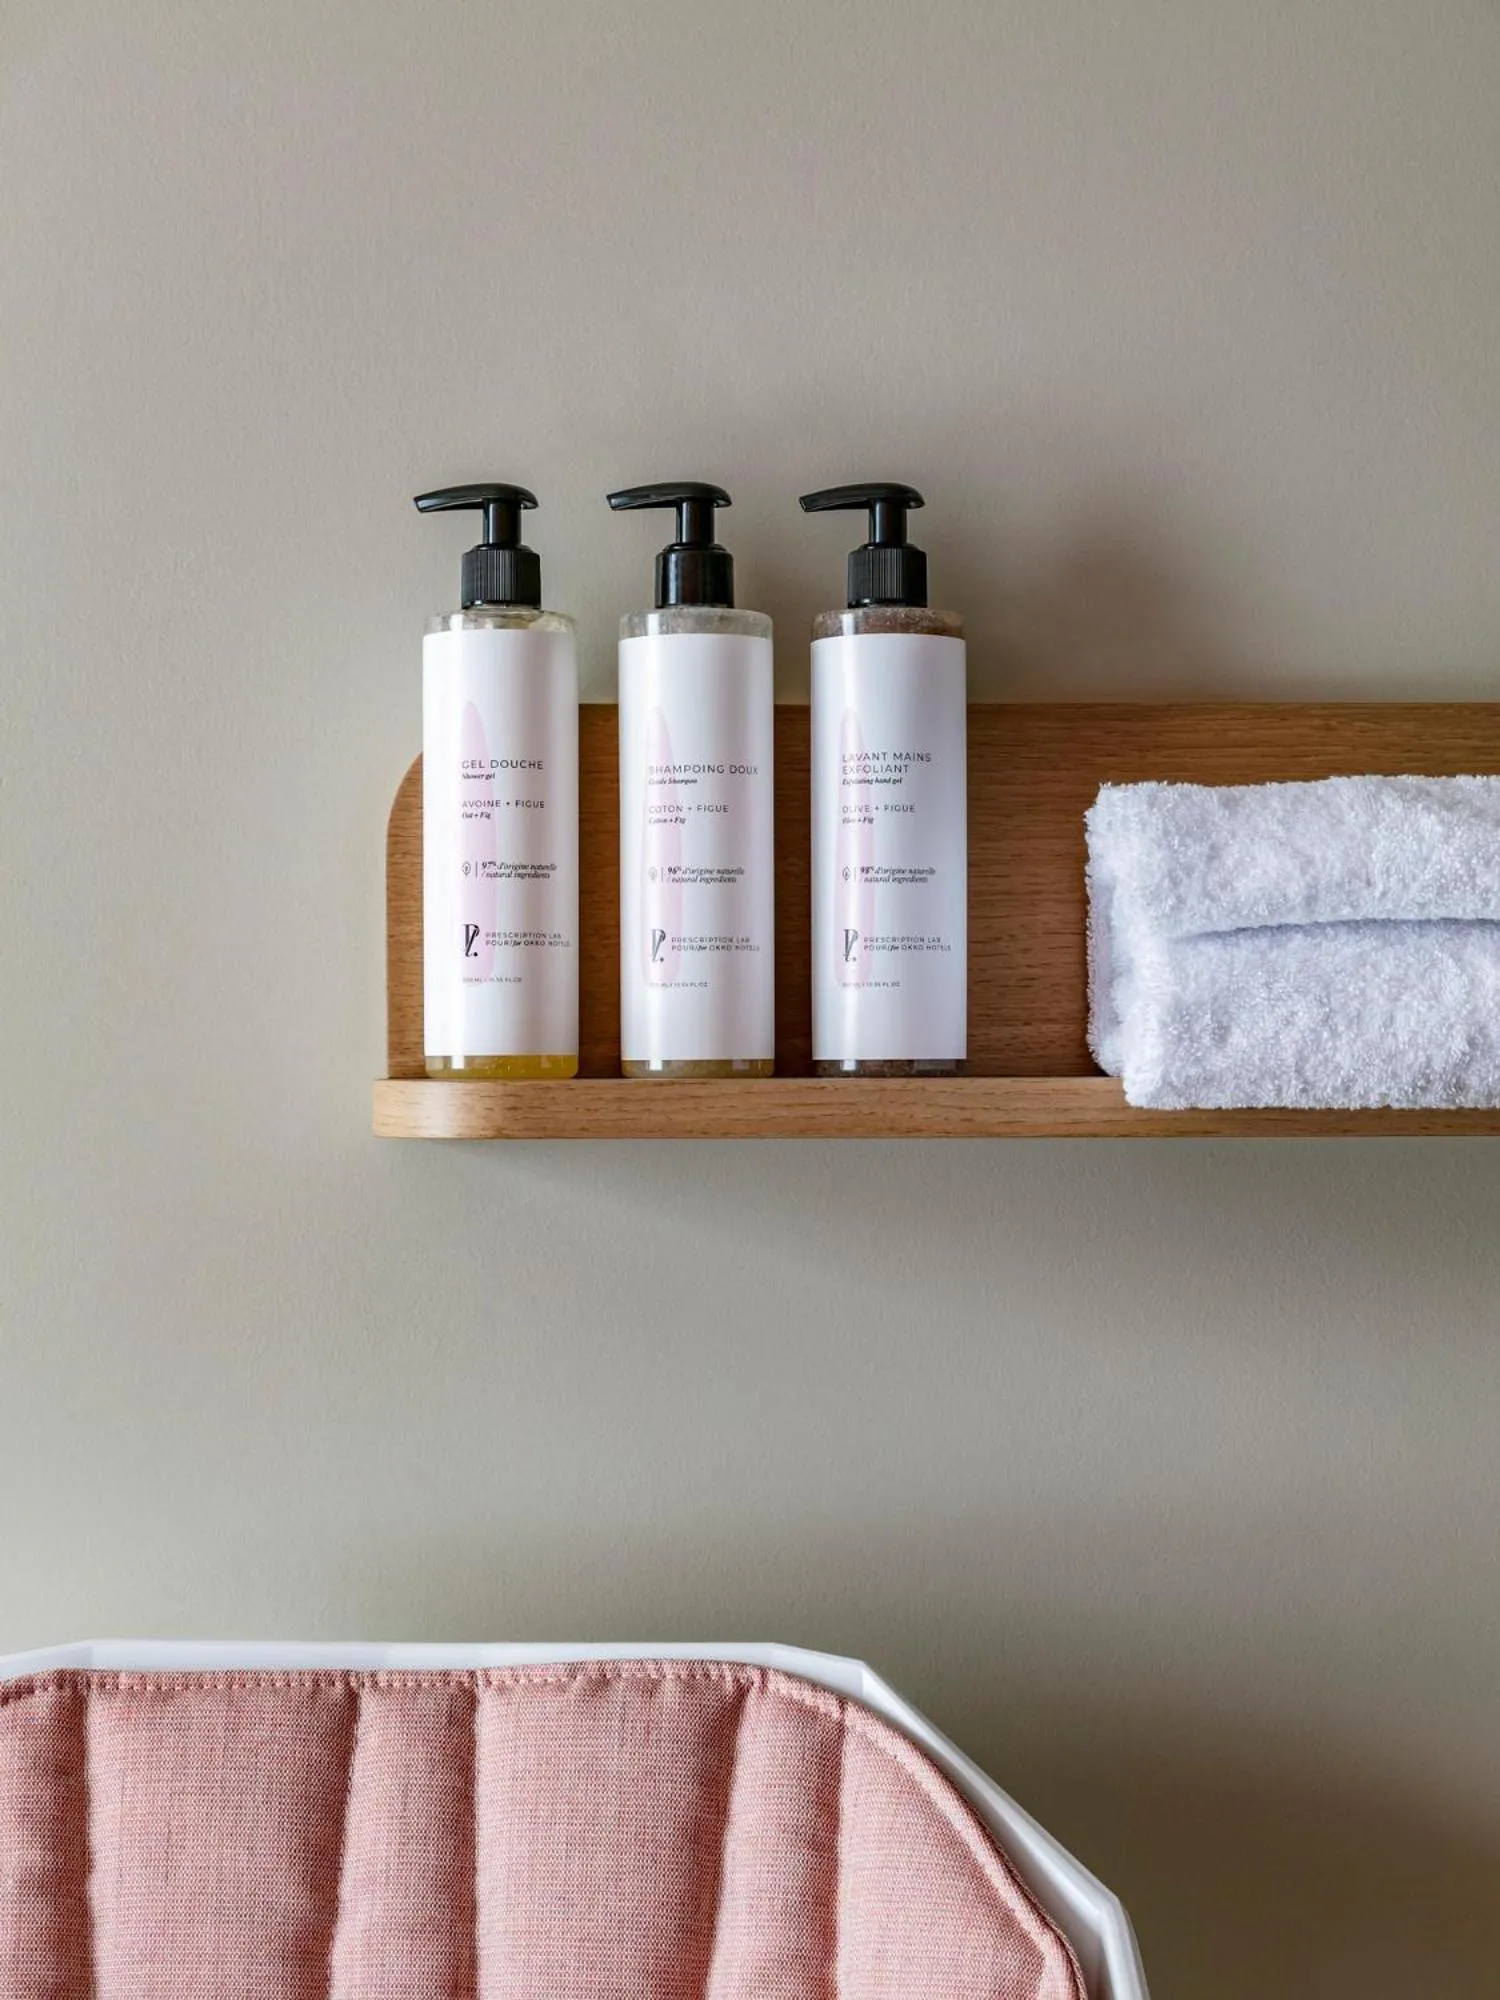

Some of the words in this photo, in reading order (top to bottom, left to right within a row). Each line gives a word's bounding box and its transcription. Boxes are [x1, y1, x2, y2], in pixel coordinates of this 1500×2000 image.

[893, 752, 932, 762] MAINS
[462, 760, 485, 769] GEL
[490, 760, 544, 770] DOUCHE
[648, 764, 724, 774] SHAMPOING
[730, 765, 758, 774] DOUX
[842, 764, 909, 774] EXFOLIANT
[462, 800, 500, 808] AVOINE
[515, 800, 544, 808] FIGUE
[648, 804, 683, 814] COTON
[697, 804, 729, 812] FIGUE
[884, 804, 916, 812] FIGUE
